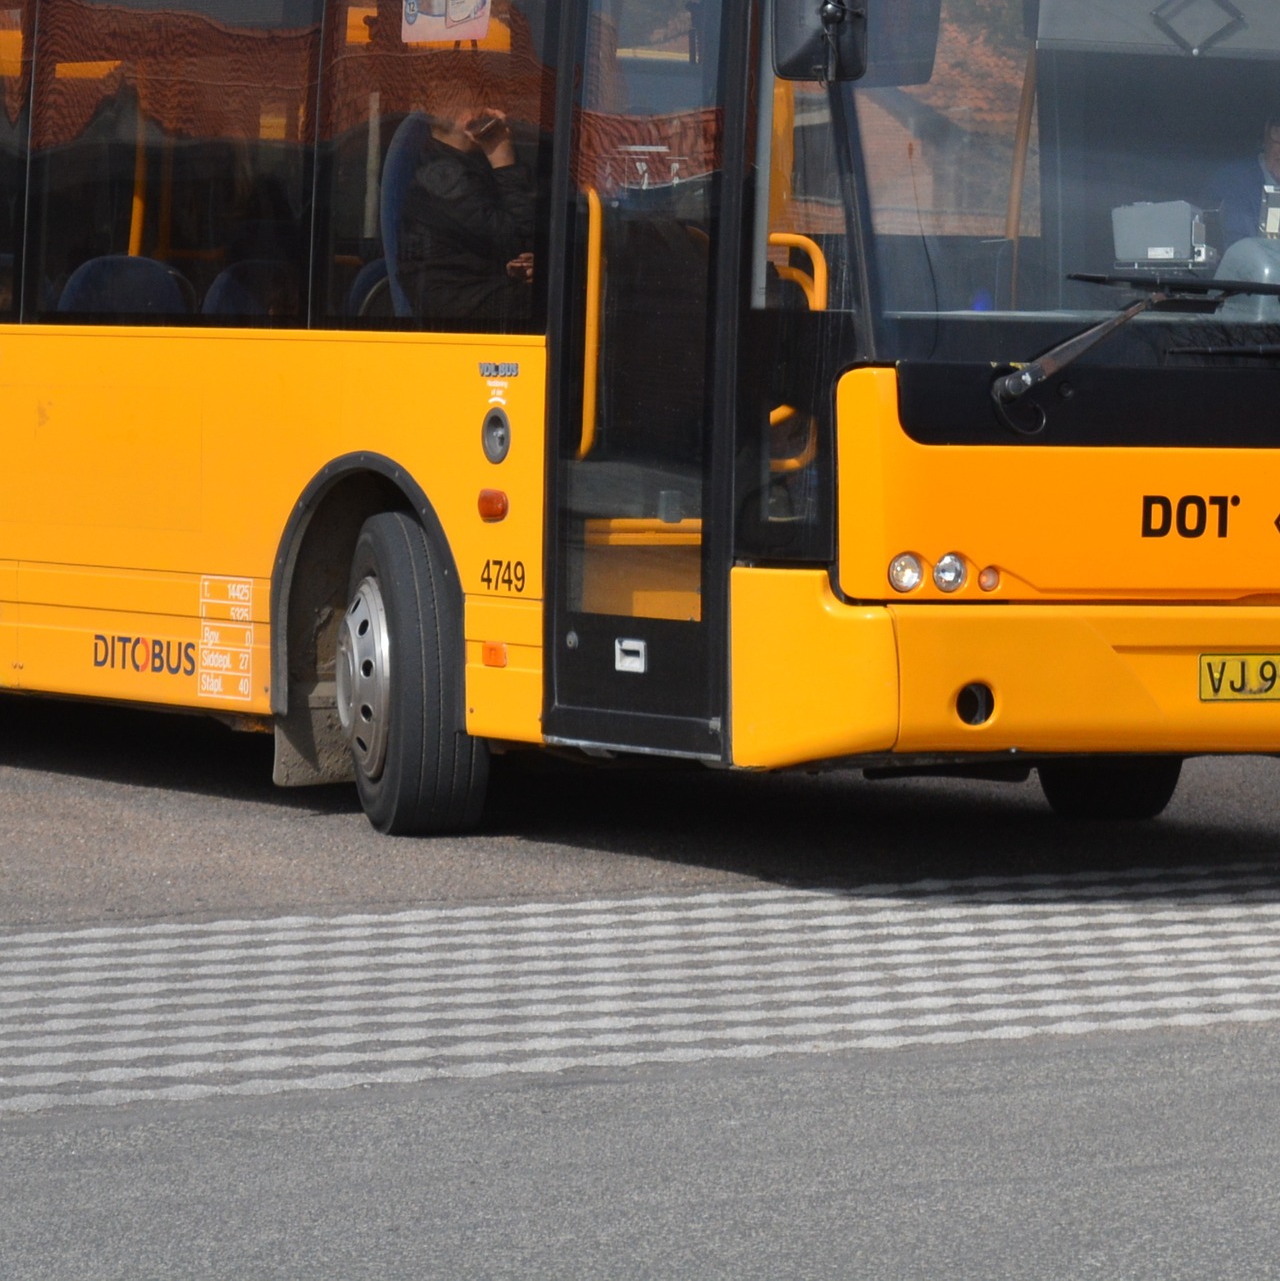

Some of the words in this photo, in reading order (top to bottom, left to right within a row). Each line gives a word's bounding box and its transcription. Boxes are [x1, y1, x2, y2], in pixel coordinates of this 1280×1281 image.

[408, 1, 415, 12] 12
[498, 362, 519, 377] BUS
[1141, 495, 1240, 538] DOT
[480, 559, 526, 593] 4749
[227, 583, 250, 600] 14425
[246, 631, 251, 647] 0
[93, 634, 196, 676] DITOBUS
[239, 652, 249, 670] 27
[1207, 661, 1246, 694] VJ
[239, 679, 249, 695] 40
